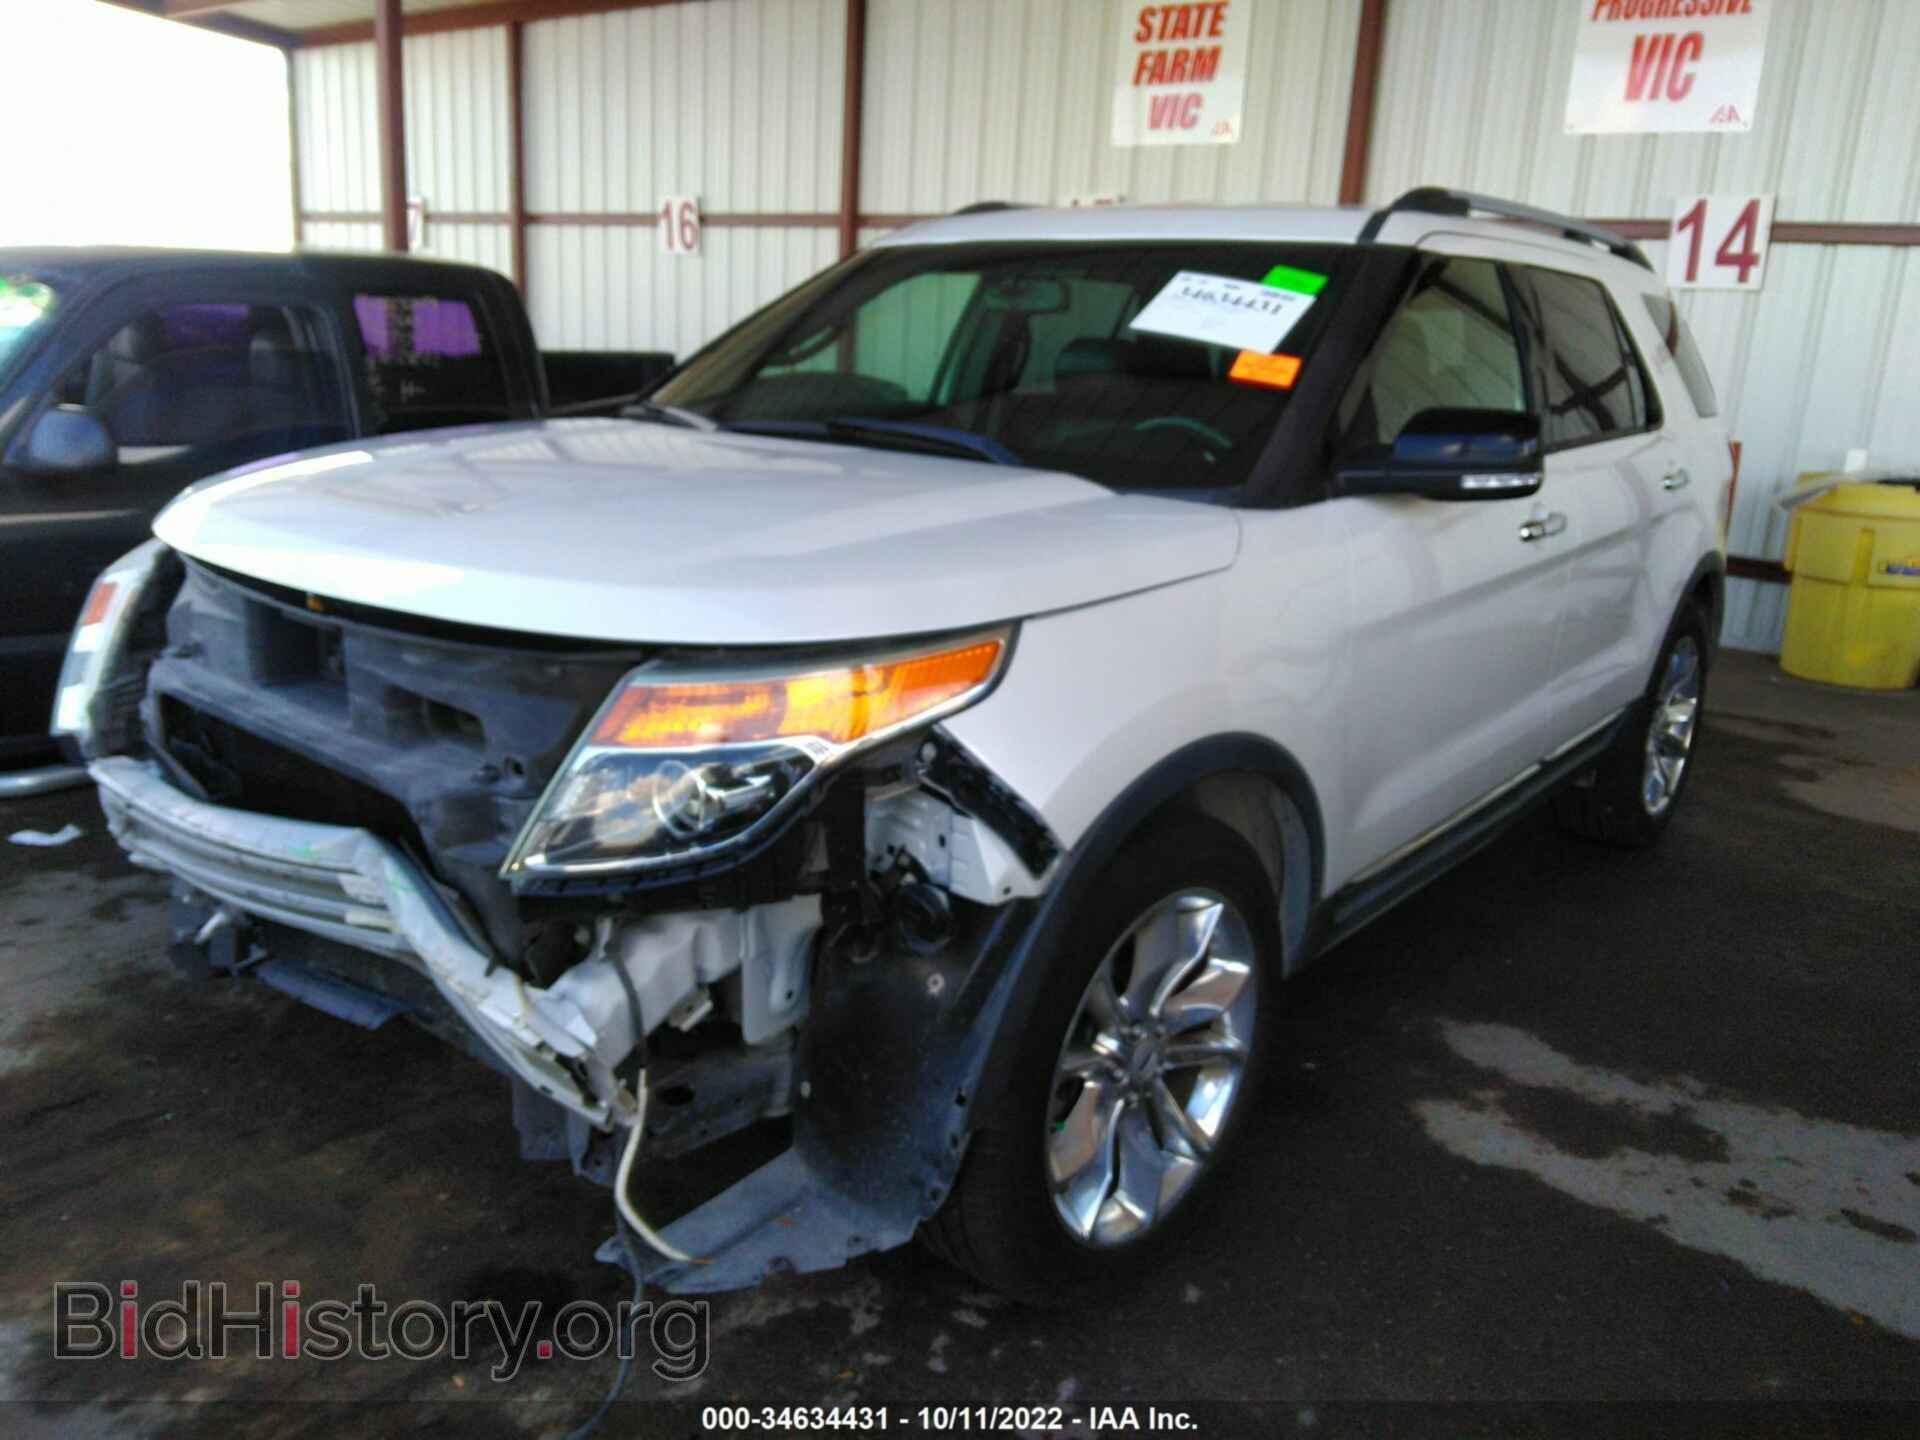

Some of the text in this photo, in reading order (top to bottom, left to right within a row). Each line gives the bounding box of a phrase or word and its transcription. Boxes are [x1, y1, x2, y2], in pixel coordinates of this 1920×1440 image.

[1135, 0, 1228, 43] STATE
[1133, 46, 1222, 86] FARM
[1625, 31, 1704, 102] VIC
[1147, 93, 1203, 130] VIC
[656, 200, 699, 250] 16
[1677, 198, 1761, 283] 14
